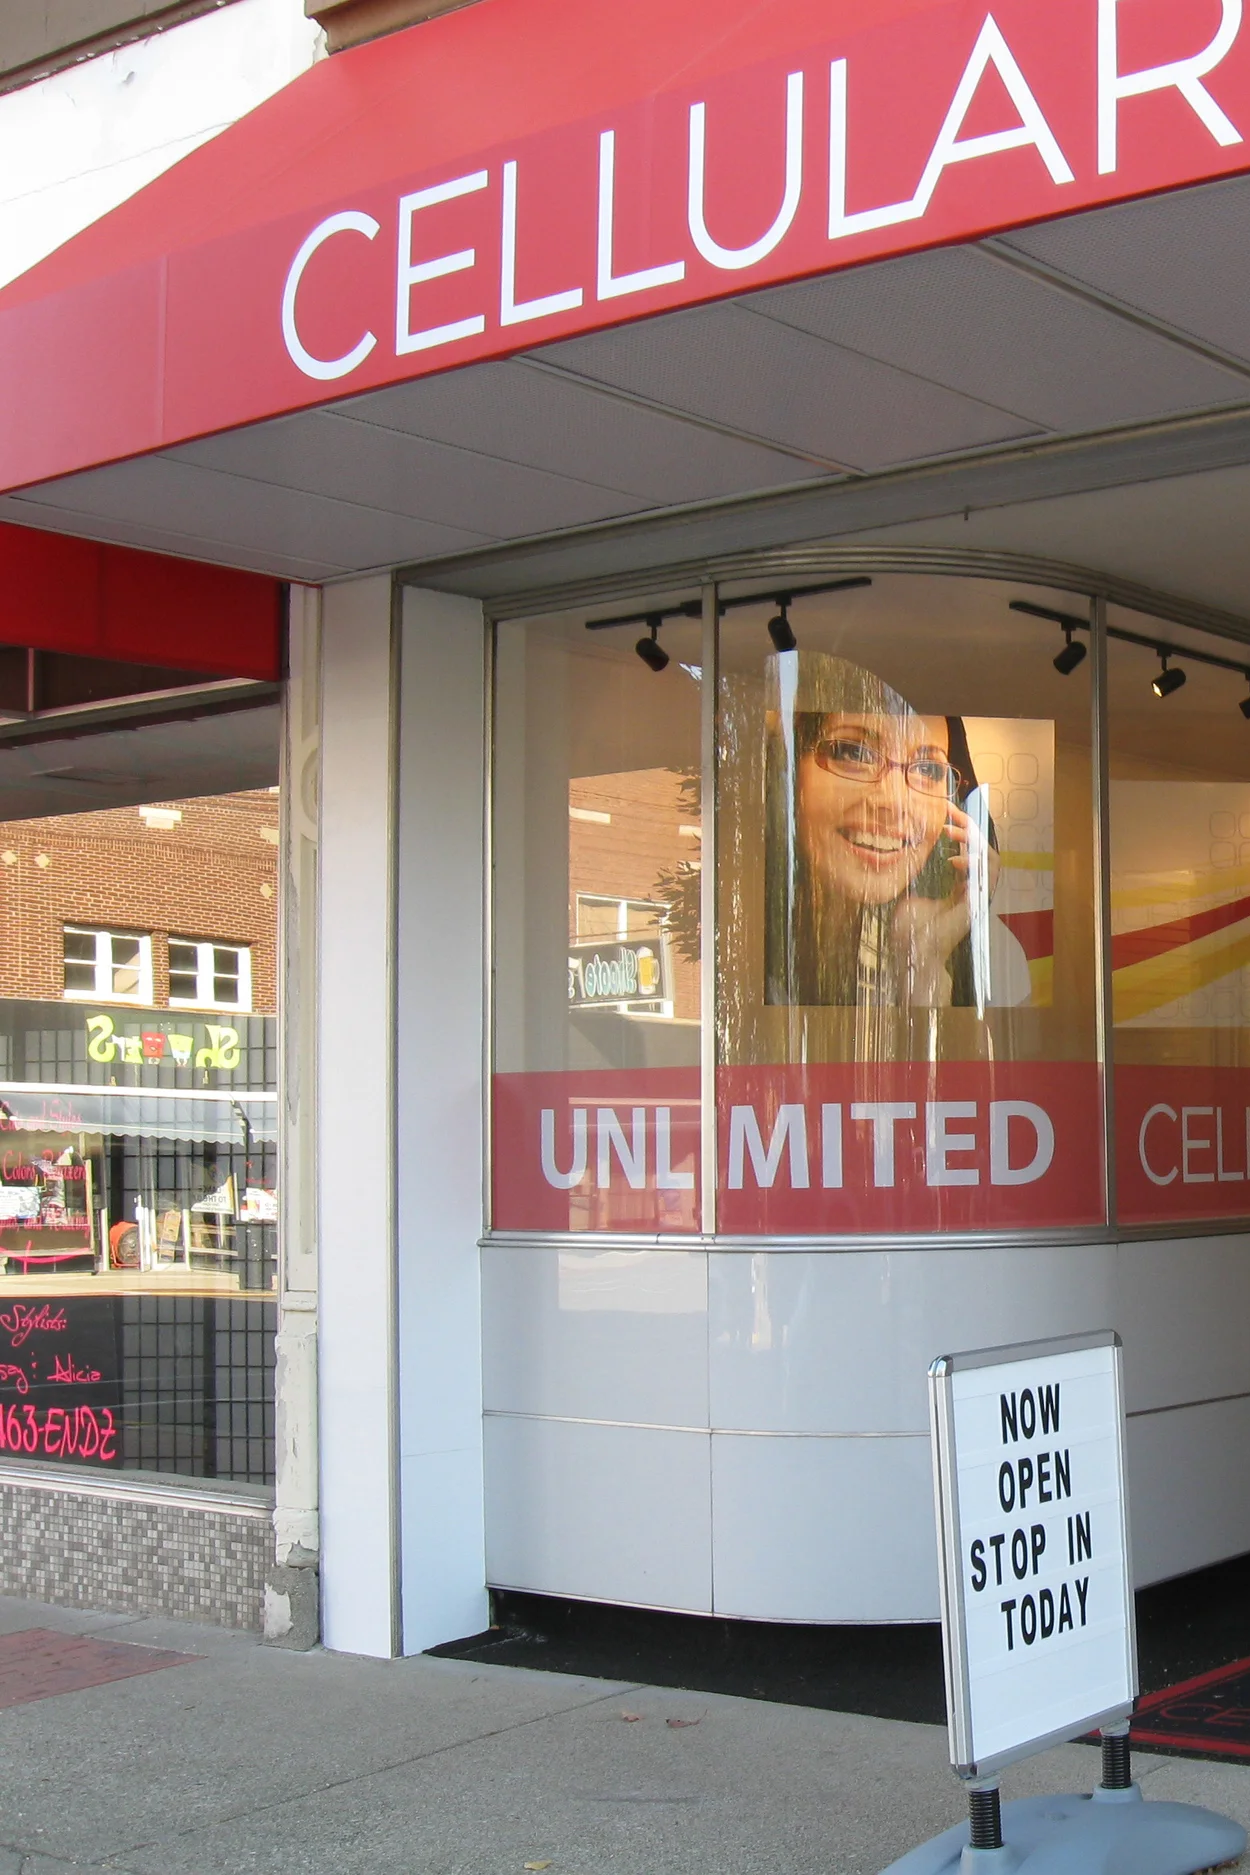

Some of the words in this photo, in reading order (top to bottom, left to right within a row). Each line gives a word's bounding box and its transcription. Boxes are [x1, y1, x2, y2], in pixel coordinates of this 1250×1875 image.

[540, 1099, 1056, 1190] UNLMITED
[47, 1353, 102, 1383] Alicia
[1000, 1383, 1061, 1445] NOW
[998, 1449, 1072, 1514] OPEN
[970, 1523, 1047, 1593] STOP
[1067, 1511, 1092, 1566] IN
[1001, 1577, 1089, 1651] TODAY
